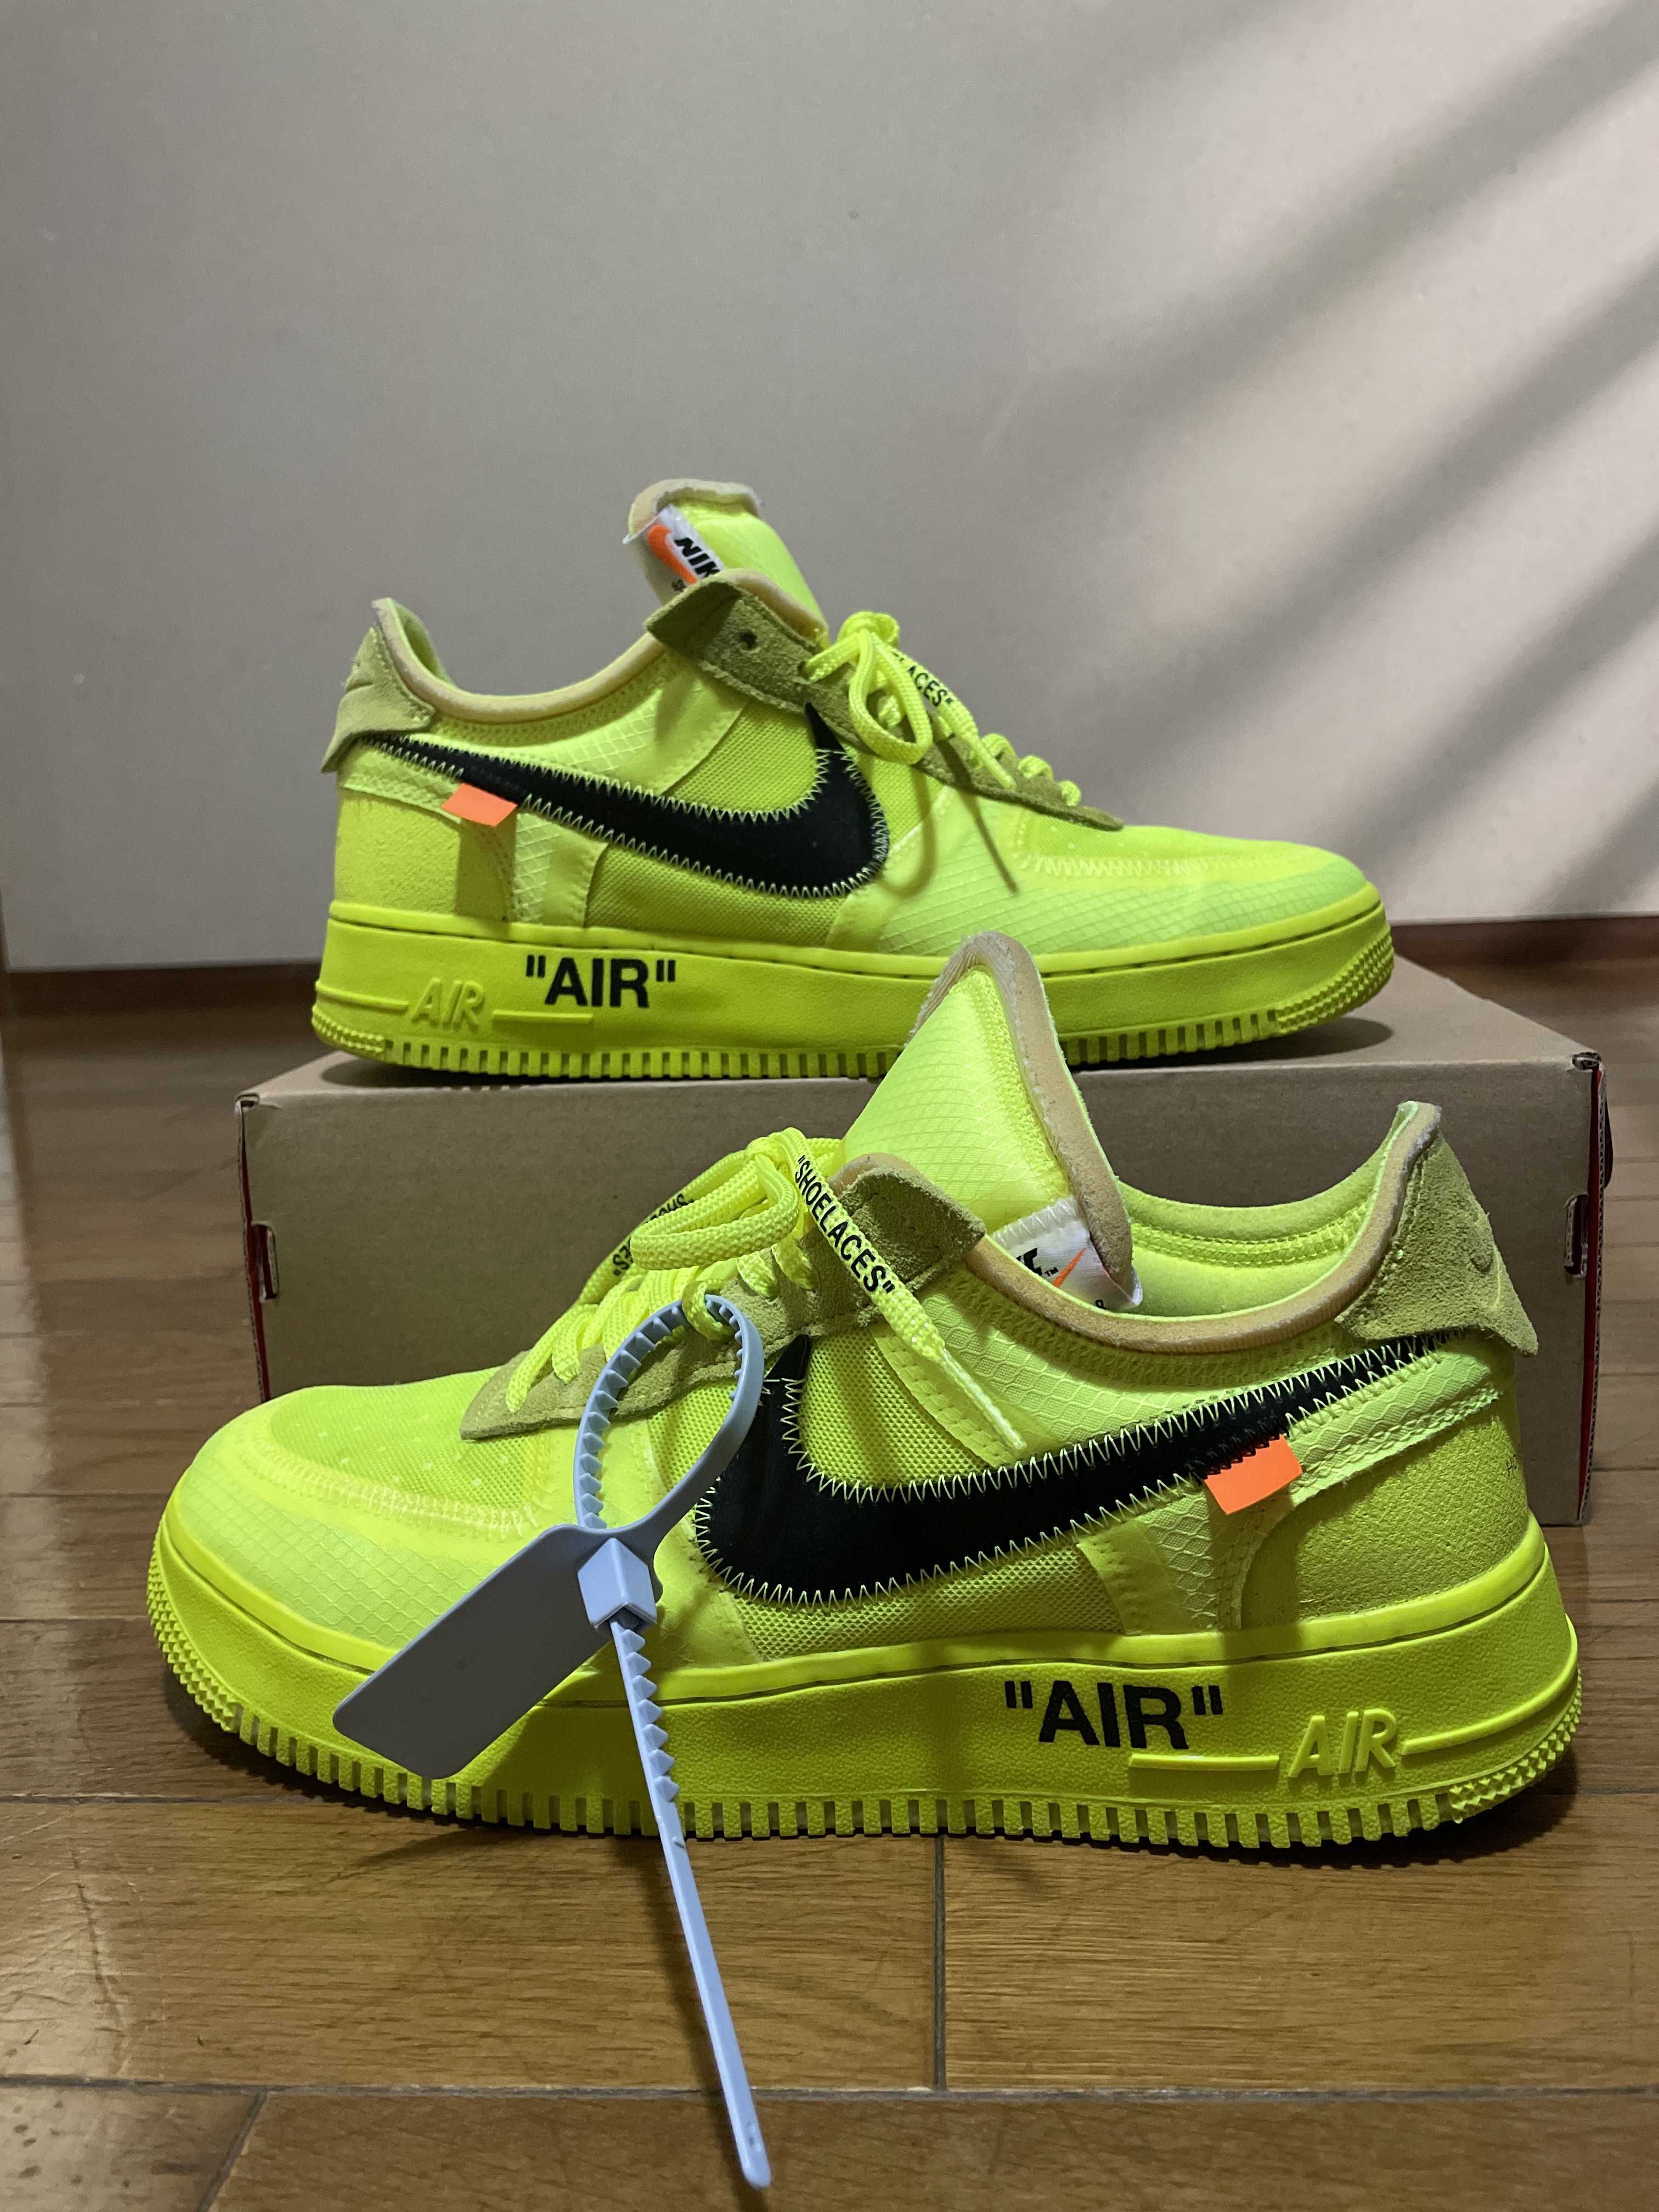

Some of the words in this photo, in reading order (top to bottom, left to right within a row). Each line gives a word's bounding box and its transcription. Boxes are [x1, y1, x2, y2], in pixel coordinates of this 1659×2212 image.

[674, 537, 720, 578] NIK
[411, 978, 485, 1029] AIR
[527, 955, 675, 1008] "AIR"
[795, 1155, 895, 1293] "SHOELACES"
[1005, 1680, 1224, 1750] "AIR"
[1288, 1708, 1396, 1778] AIR
